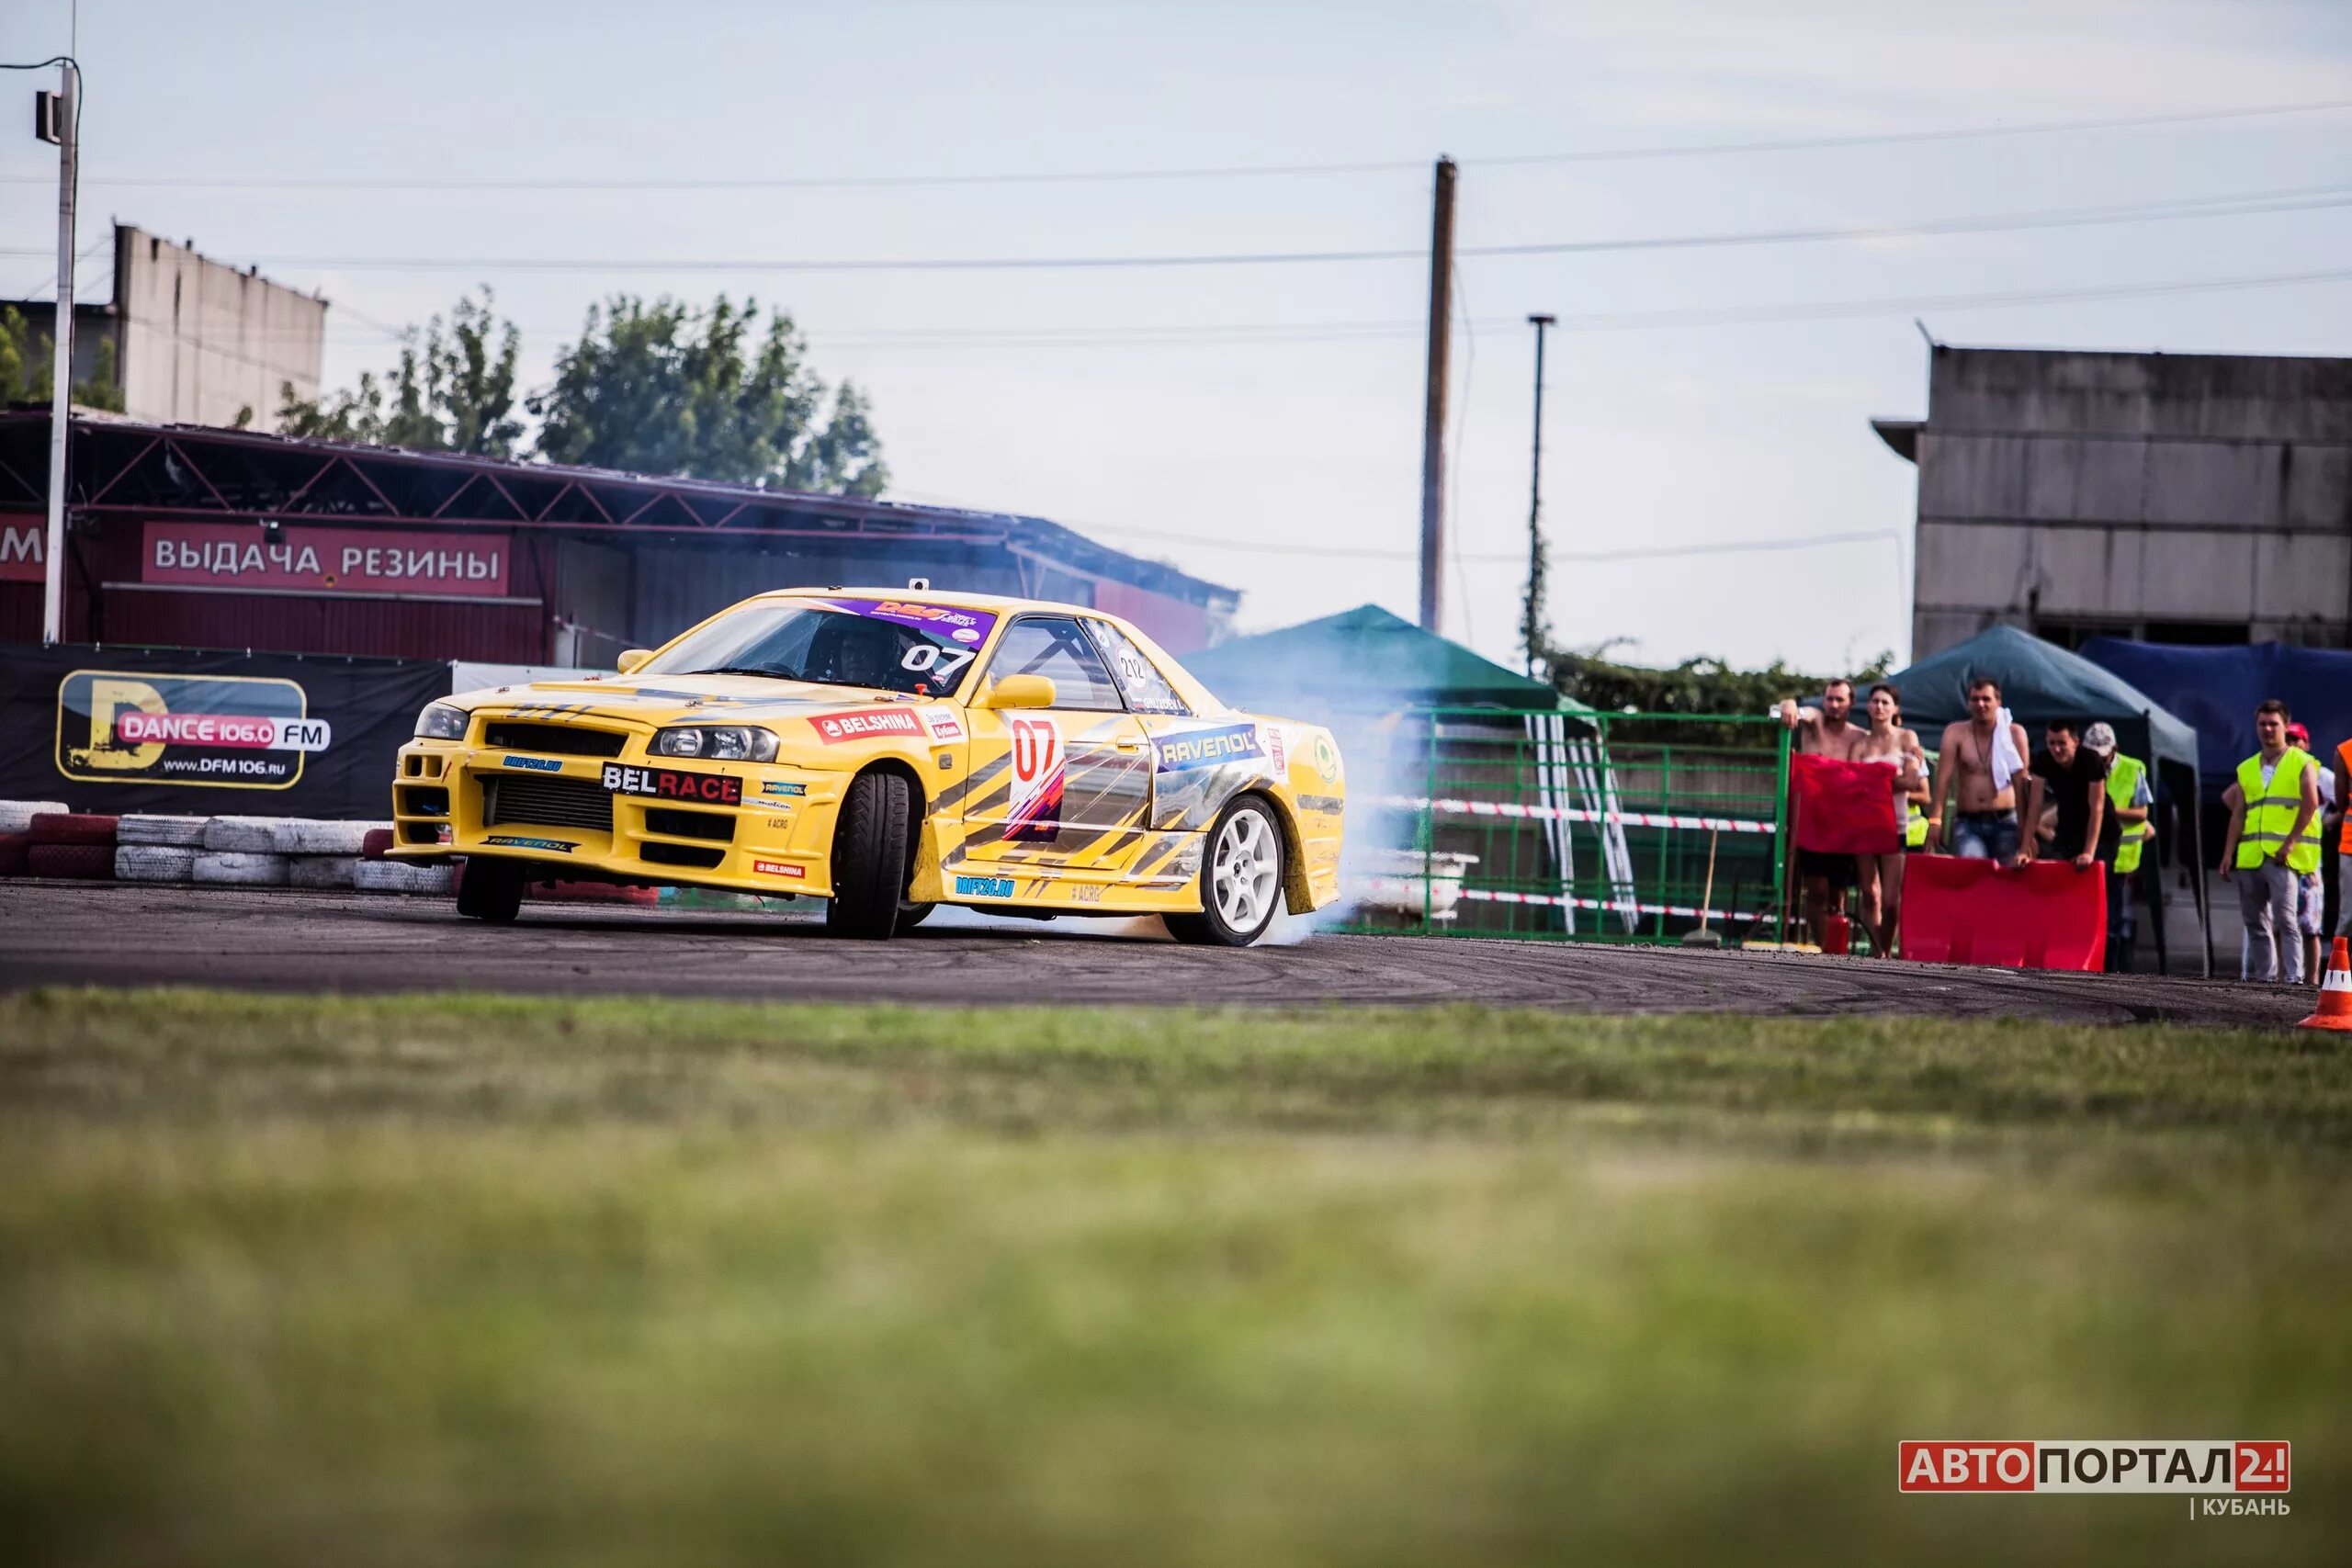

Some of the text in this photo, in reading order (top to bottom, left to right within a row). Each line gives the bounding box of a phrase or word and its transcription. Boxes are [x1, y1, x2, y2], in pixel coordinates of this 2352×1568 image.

[155, 540, 498, 580] ВЫДАЧА РЕЗИНЫ
[900, 645, 977, 677] 07
[1119, 656, 1145, 679] 212
[124, 717, 322, 745] DANCE 106.0 FM
[839, 713, 917, 734] BELSHINA
[1012, 719, 1056, 783] 07
[1162, 732, 1258, 764] RAVENOL
[504, 757, 562, 772] DRIFT26.RU
[765, 784, 804, 794] RAVENOL
[758, 800, 791, 809] motion
[489, 838, 568, 851] RAVENOL
[765, 864, 802, 876] BELSHINA
[956, 876, 1014, 897] DRIFT26.RU
[1079, 886, 1100, 902] ACRG
